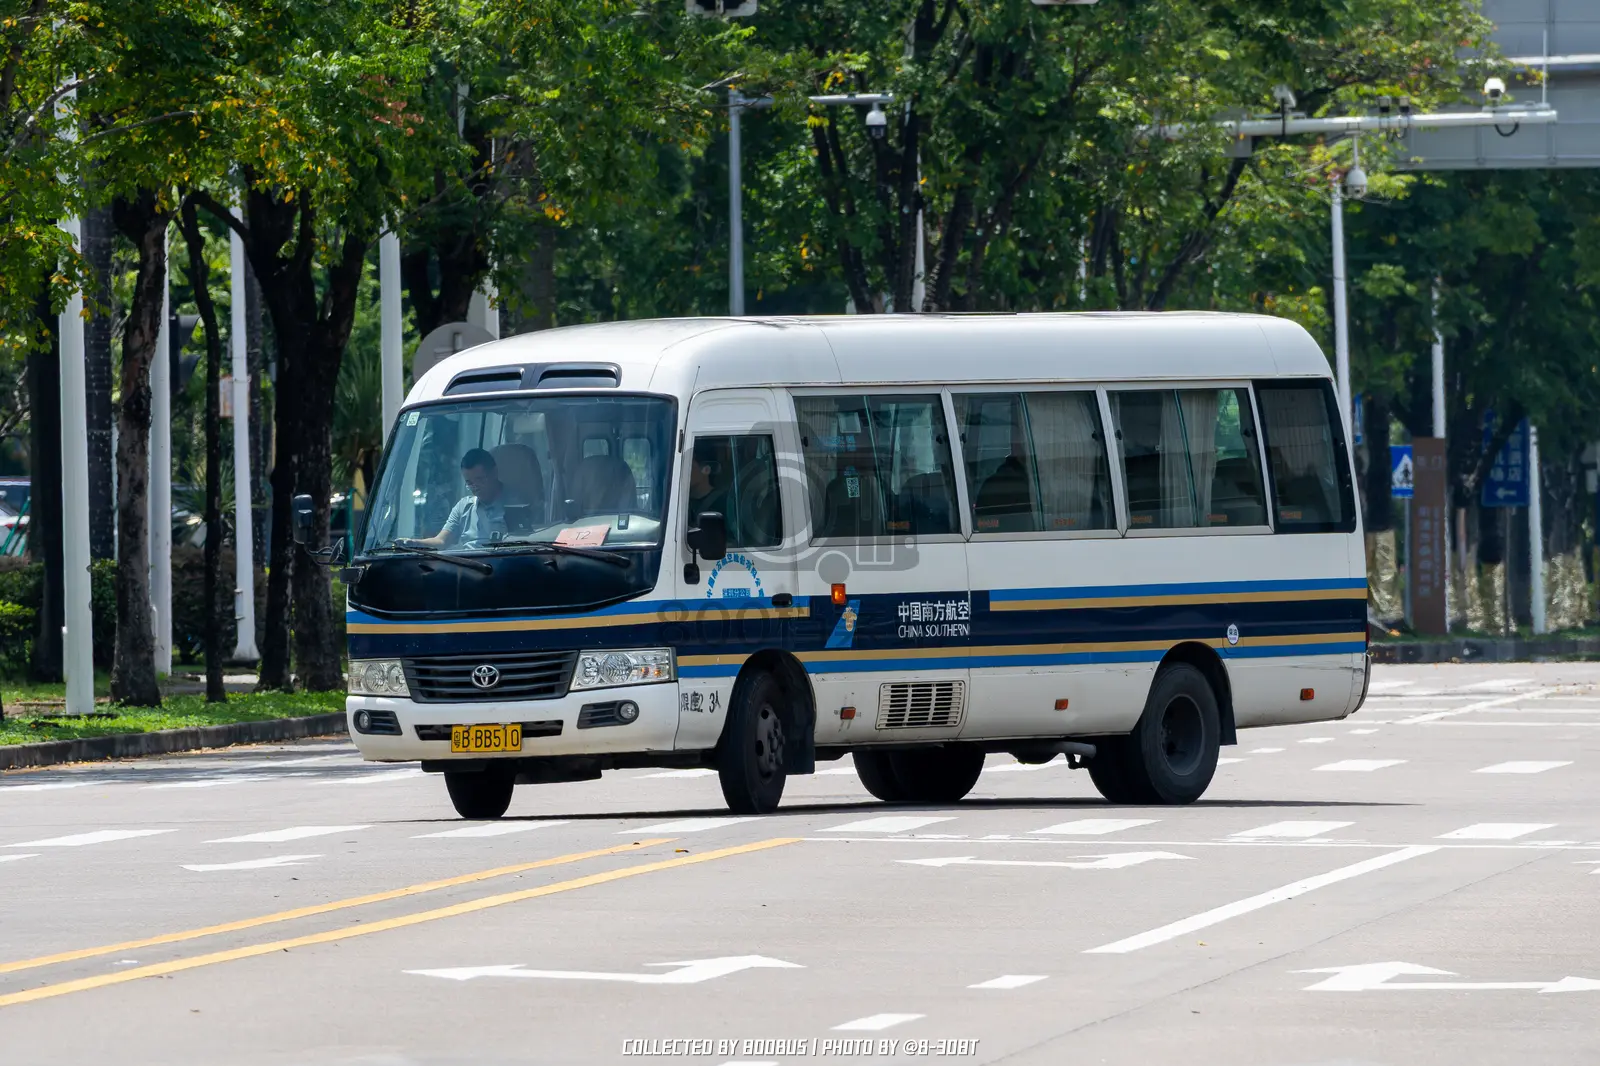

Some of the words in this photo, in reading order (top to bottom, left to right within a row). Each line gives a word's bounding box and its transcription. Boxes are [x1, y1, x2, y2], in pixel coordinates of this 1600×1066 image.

[898, 600, 969, 623] 中国南方航空
[898, 624, 924, 638] CHINA
[925, 623, 970, 637] SOUTHERN
